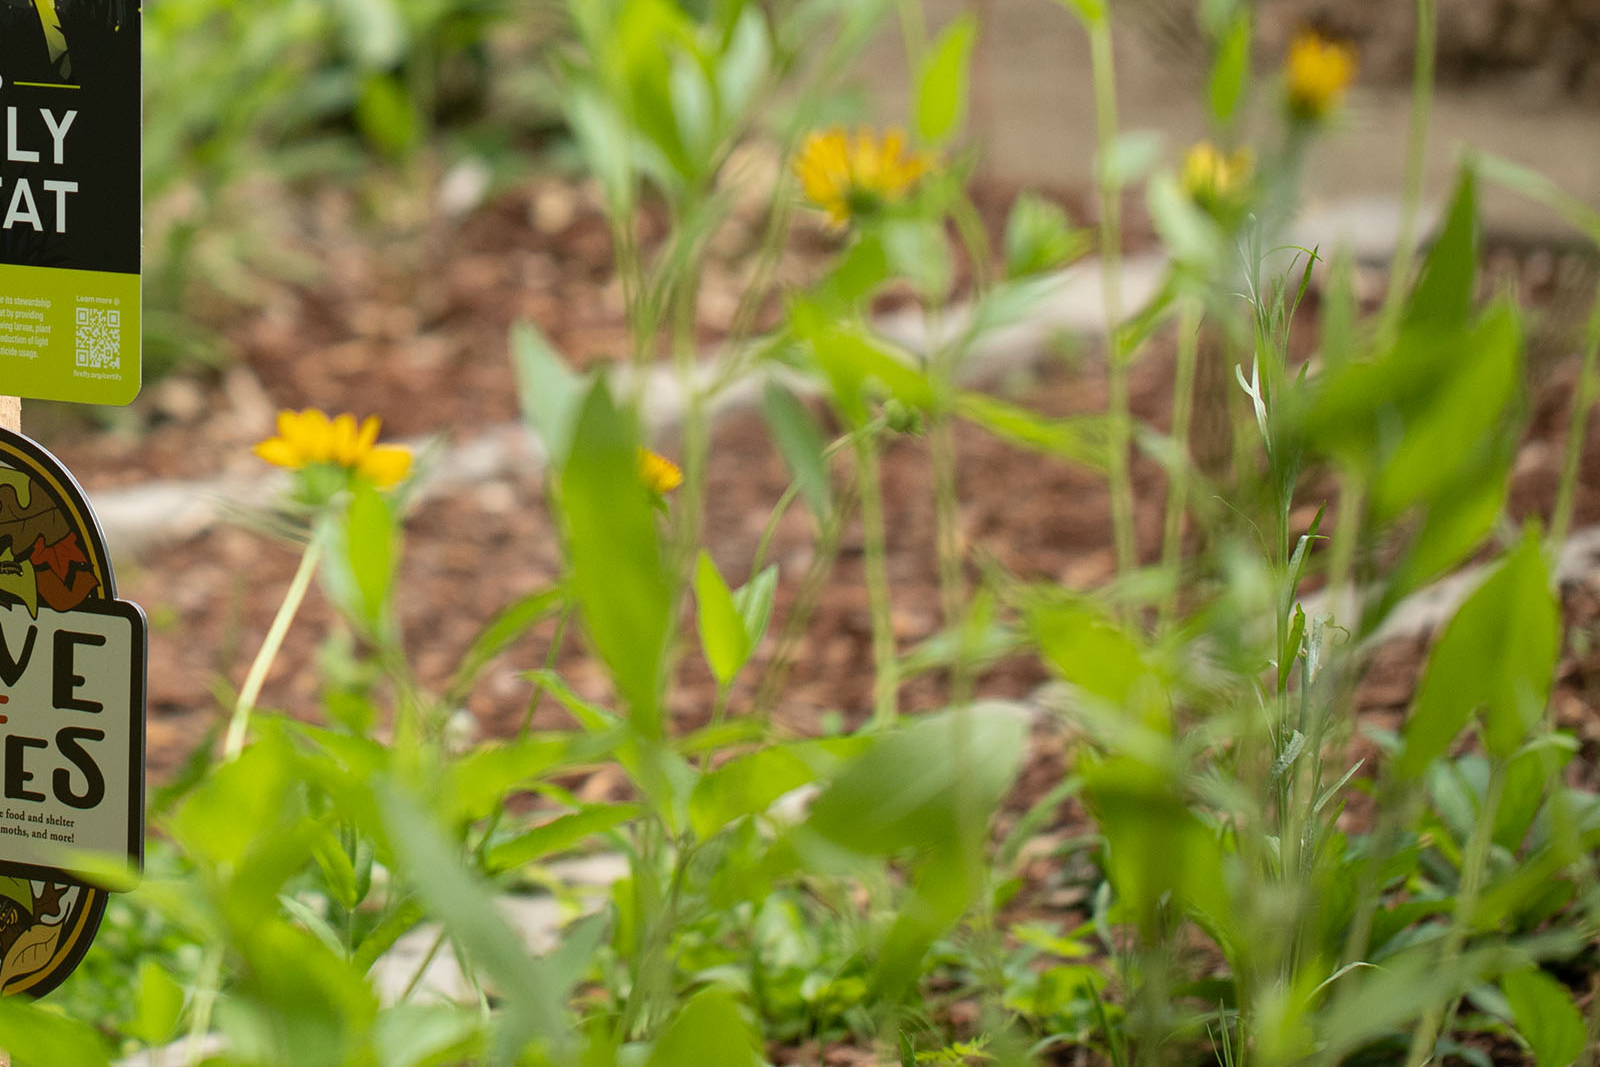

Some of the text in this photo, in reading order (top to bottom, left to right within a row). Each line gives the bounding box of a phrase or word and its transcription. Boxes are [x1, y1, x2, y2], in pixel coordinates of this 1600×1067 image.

[5, 808, 26, 821] food
[27, 813, 44, 823] and
[45, 814, 76, 828] shelter
[0, 825, 30, 838] moths,
[31, 829, 48, 840] and
[49, 833, 76, 844] more!
